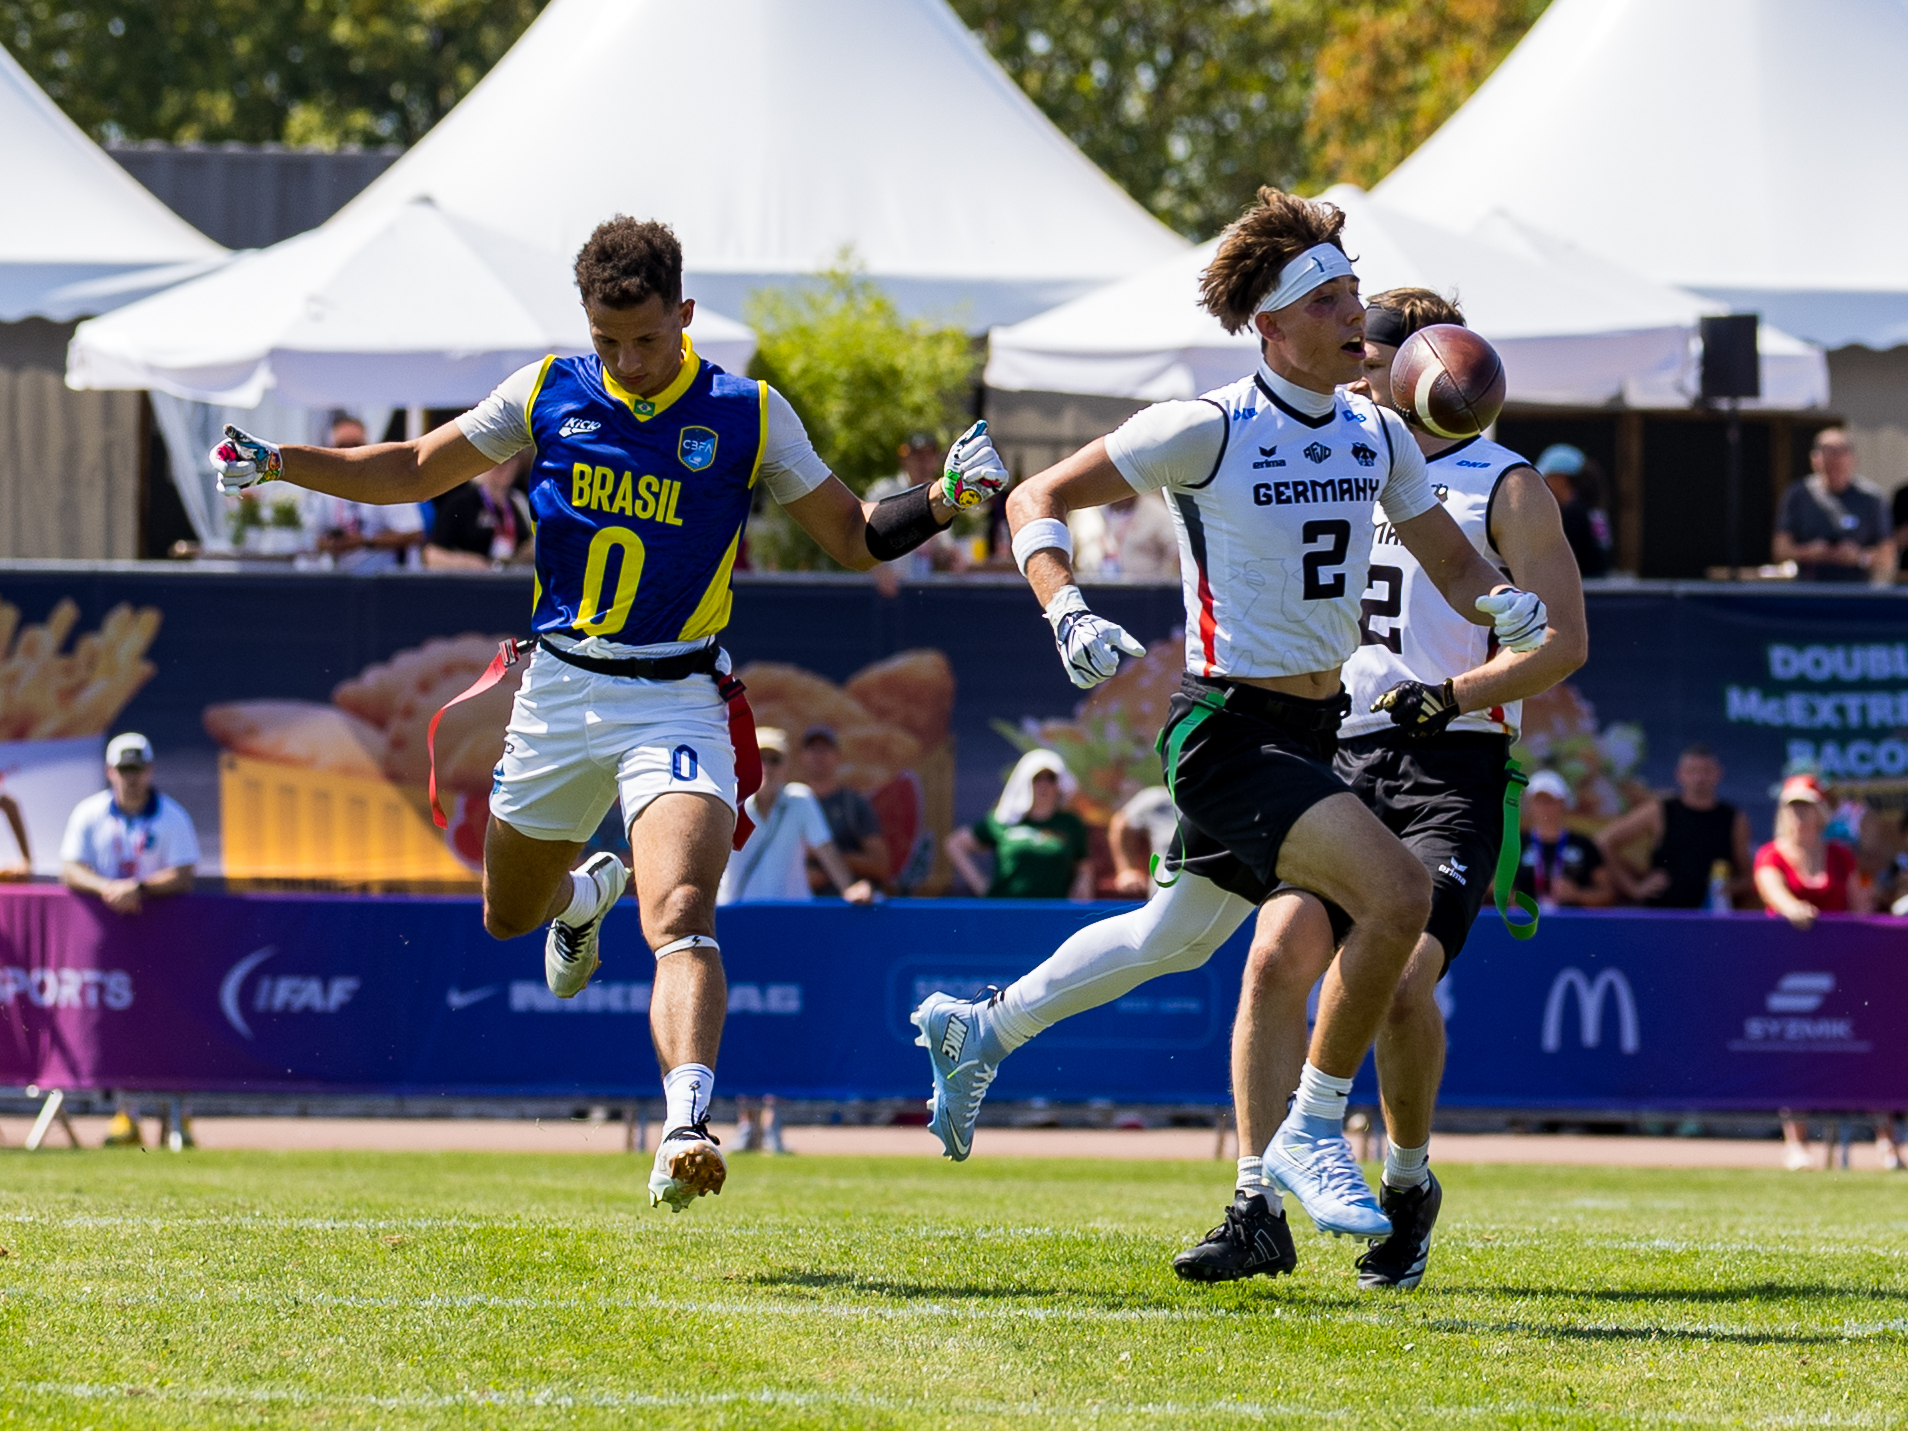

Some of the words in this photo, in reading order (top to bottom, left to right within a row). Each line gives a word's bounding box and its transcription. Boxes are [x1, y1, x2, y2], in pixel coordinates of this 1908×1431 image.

[1252, 459, 1286, 469] erima
[1456, 460, 1491, 468] DKB
[571, 462, 683, 526] BRASIL
[1252, 478, 1379, 506] GERMANY
[1302, 519, 1351, 600] 2
[572, 526, 645, 636] 0
[672, 744, 699, 782] 0
[1438, 864, 1467, 886] erima
[254, 975, 362, 1013] IFAF
[942, 1014, 968, 1062] NIKE
